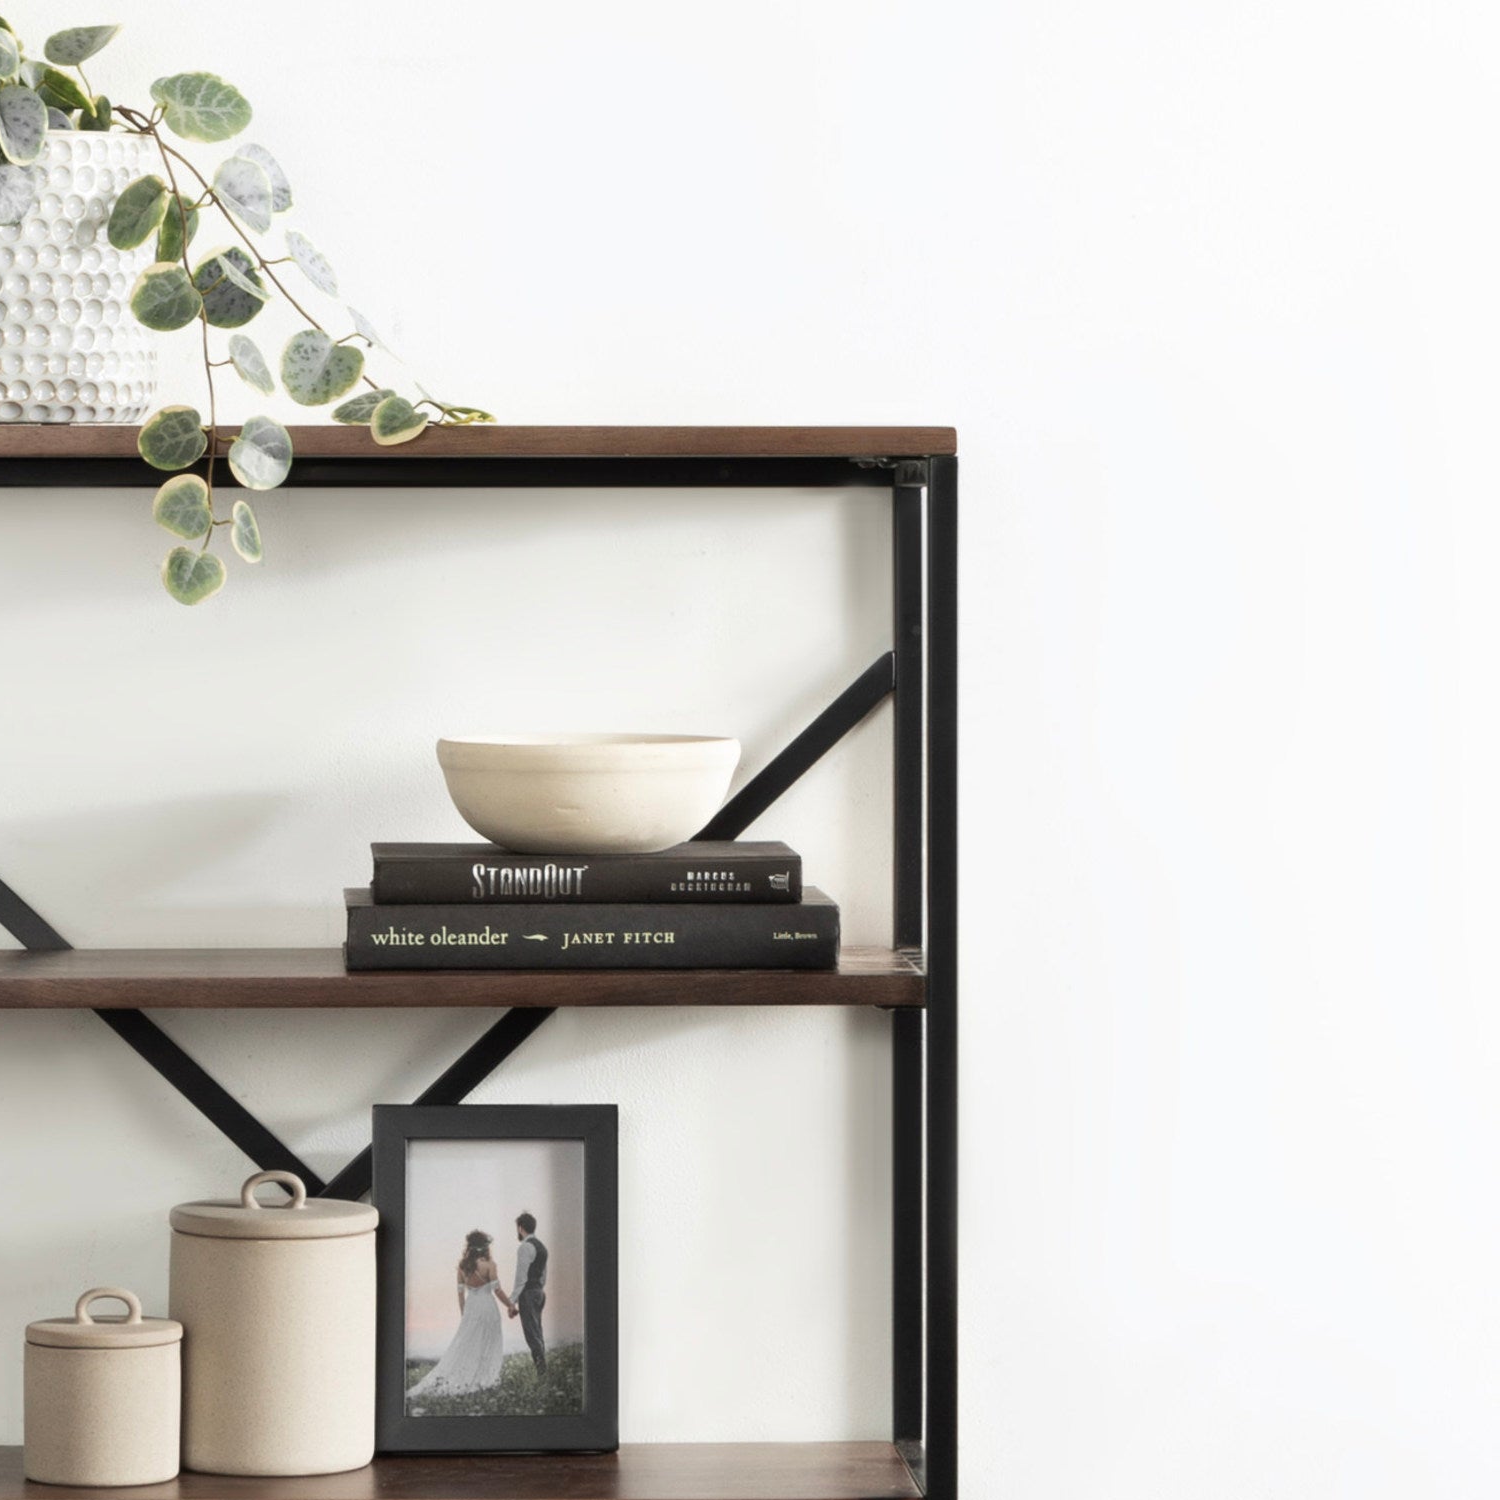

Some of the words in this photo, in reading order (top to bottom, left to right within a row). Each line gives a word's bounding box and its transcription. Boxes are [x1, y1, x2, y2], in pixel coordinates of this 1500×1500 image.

[687, 871, 736, 881] MARCUS
[370, 926, 425, 945] white
[430, 926, 509, 945] oleander
[561, 933, 616, 950] JANET
[623, 932, 676, 944] FITCH
